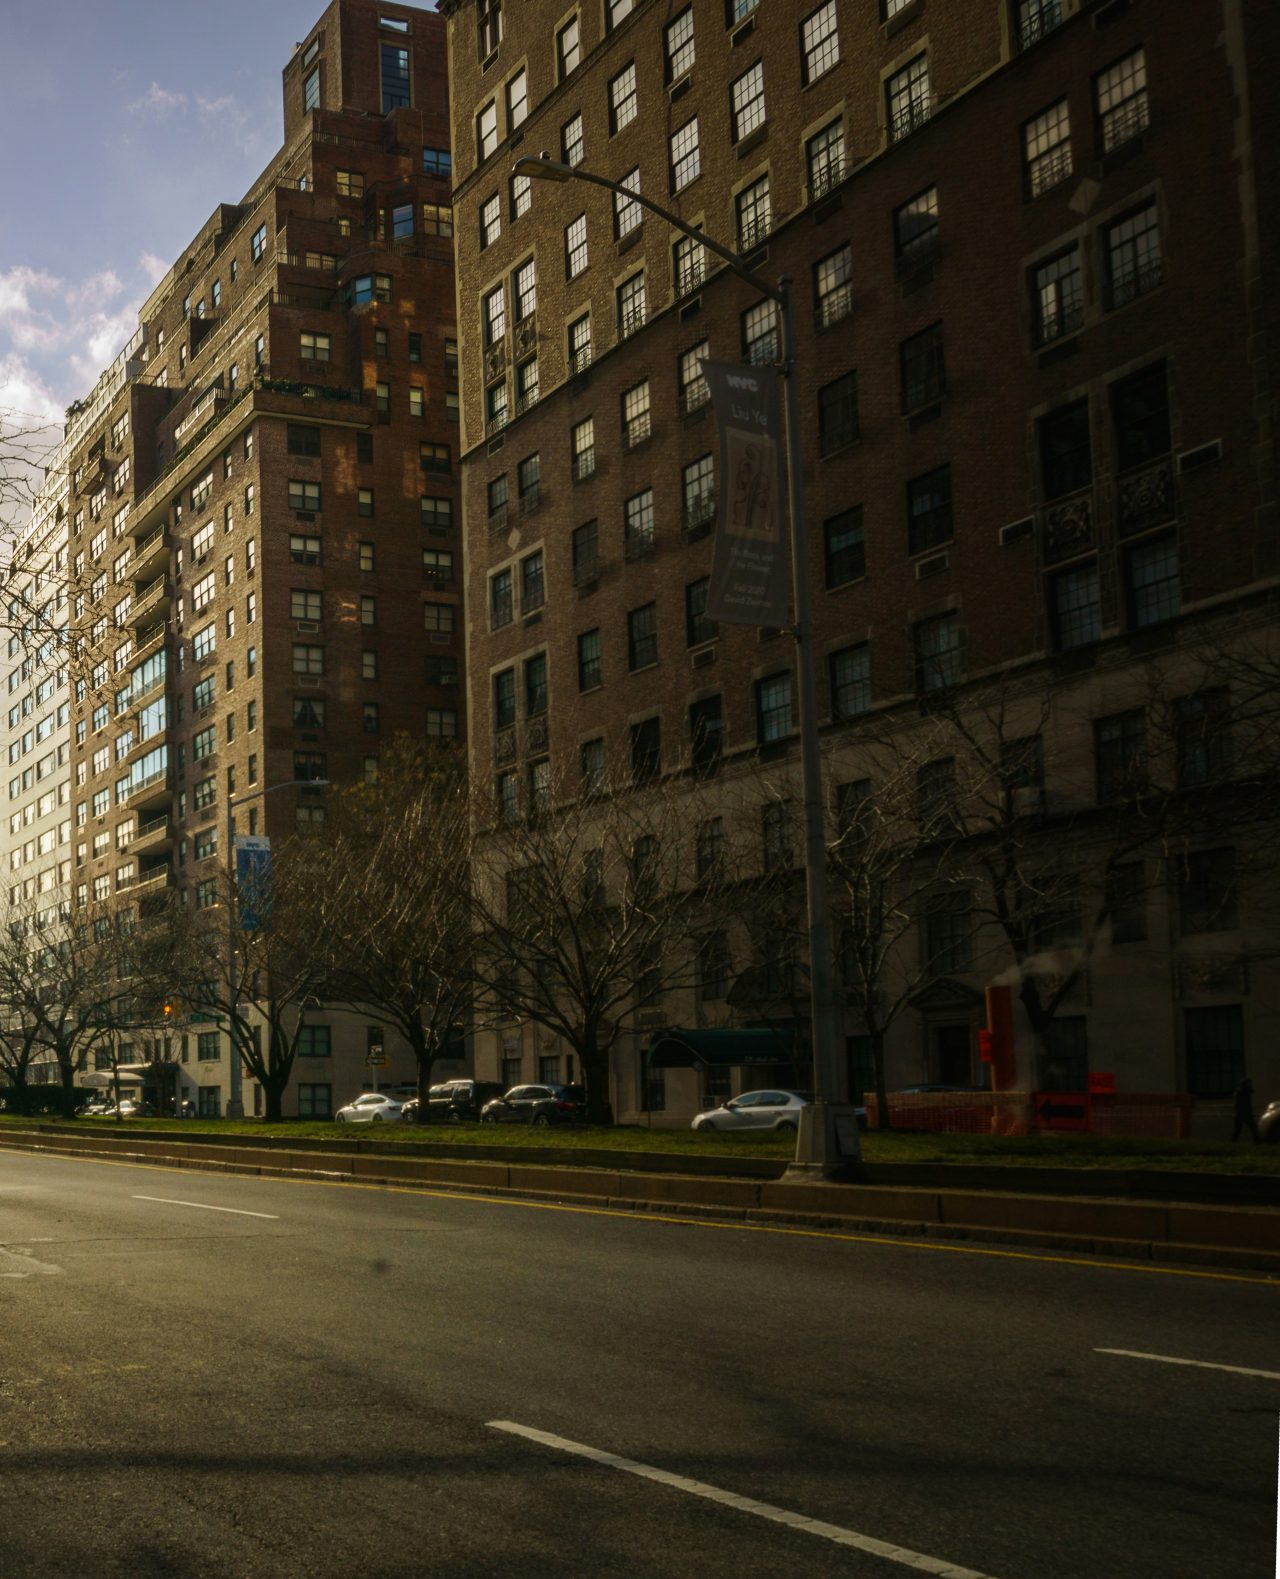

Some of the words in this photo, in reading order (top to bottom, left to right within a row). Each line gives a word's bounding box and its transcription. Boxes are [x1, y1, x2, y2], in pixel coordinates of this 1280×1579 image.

[726, 375, 758, 392] NYC
[731, 403, 750, 421] Liu
[752, 407, 768, 426] Ye
